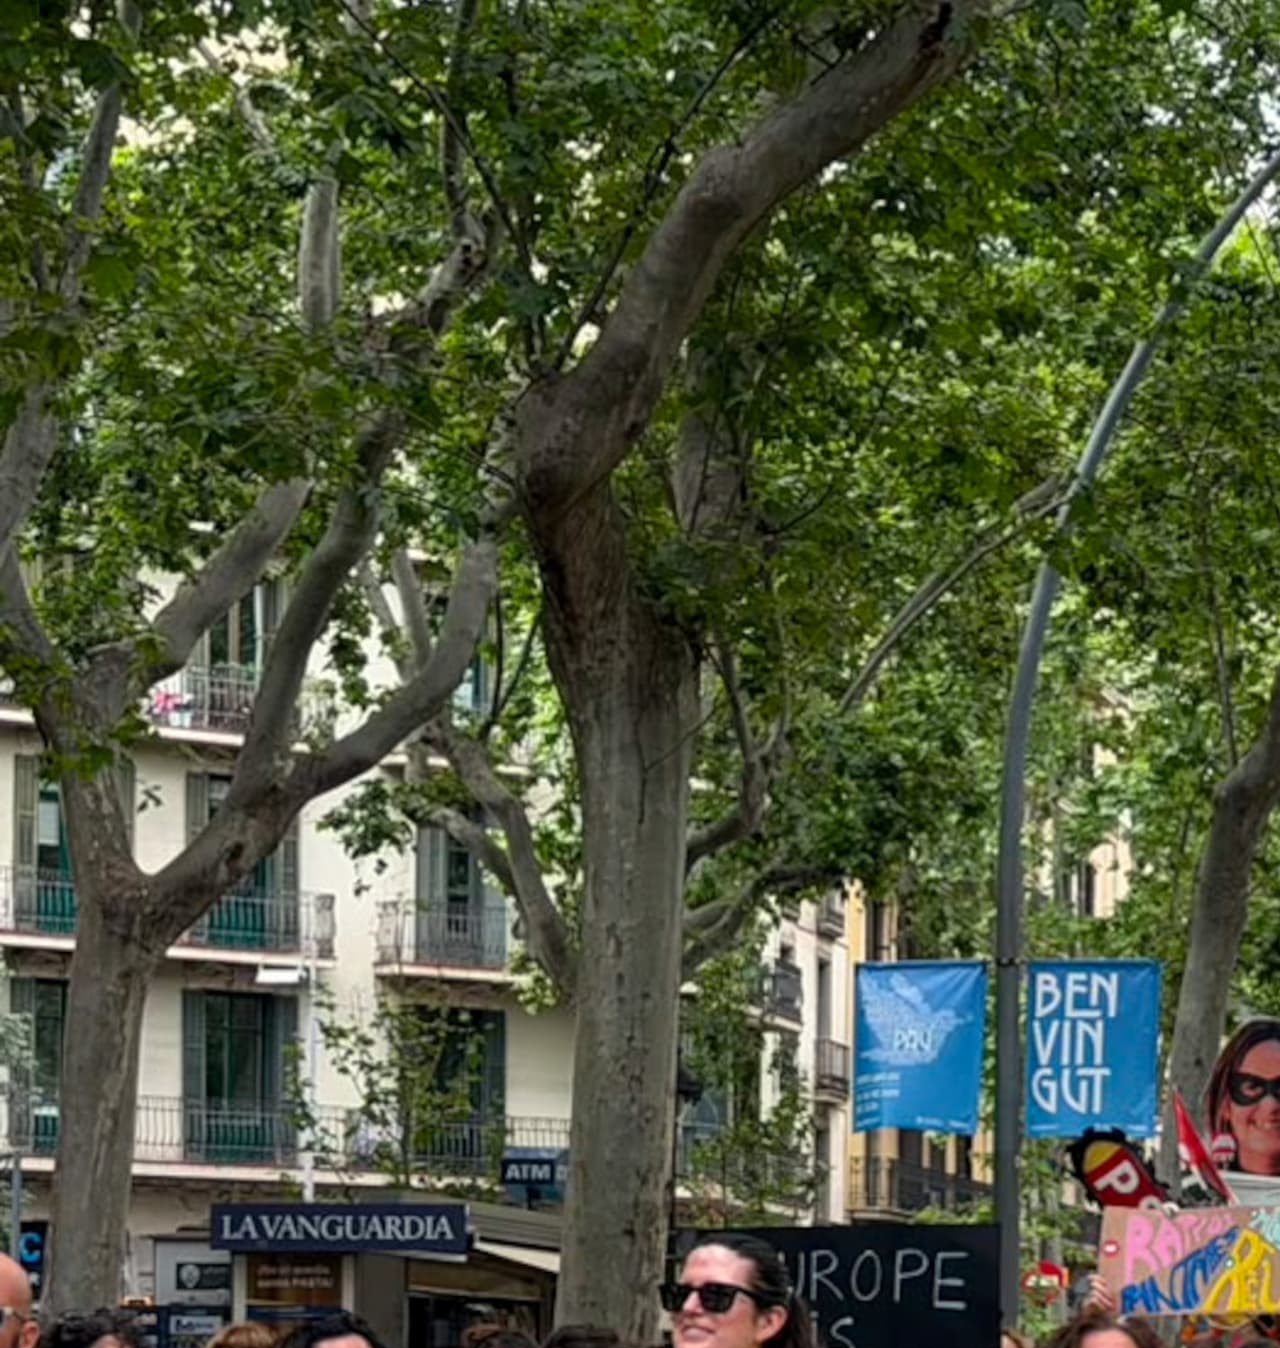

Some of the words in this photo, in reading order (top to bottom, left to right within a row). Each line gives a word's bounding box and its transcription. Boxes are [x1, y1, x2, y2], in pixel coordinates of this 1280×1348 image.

[1034, 971, 1119, 1018] BEN
[1031, 1018, 1105, 1066] VIN
[1030, 1067, 1111, 1115] GUT
[506, 1163, 550, 1181] ATM
[221, 1214, 259, 1241] LA
[260, 1214, 453, 1241] VANGUARDIA
